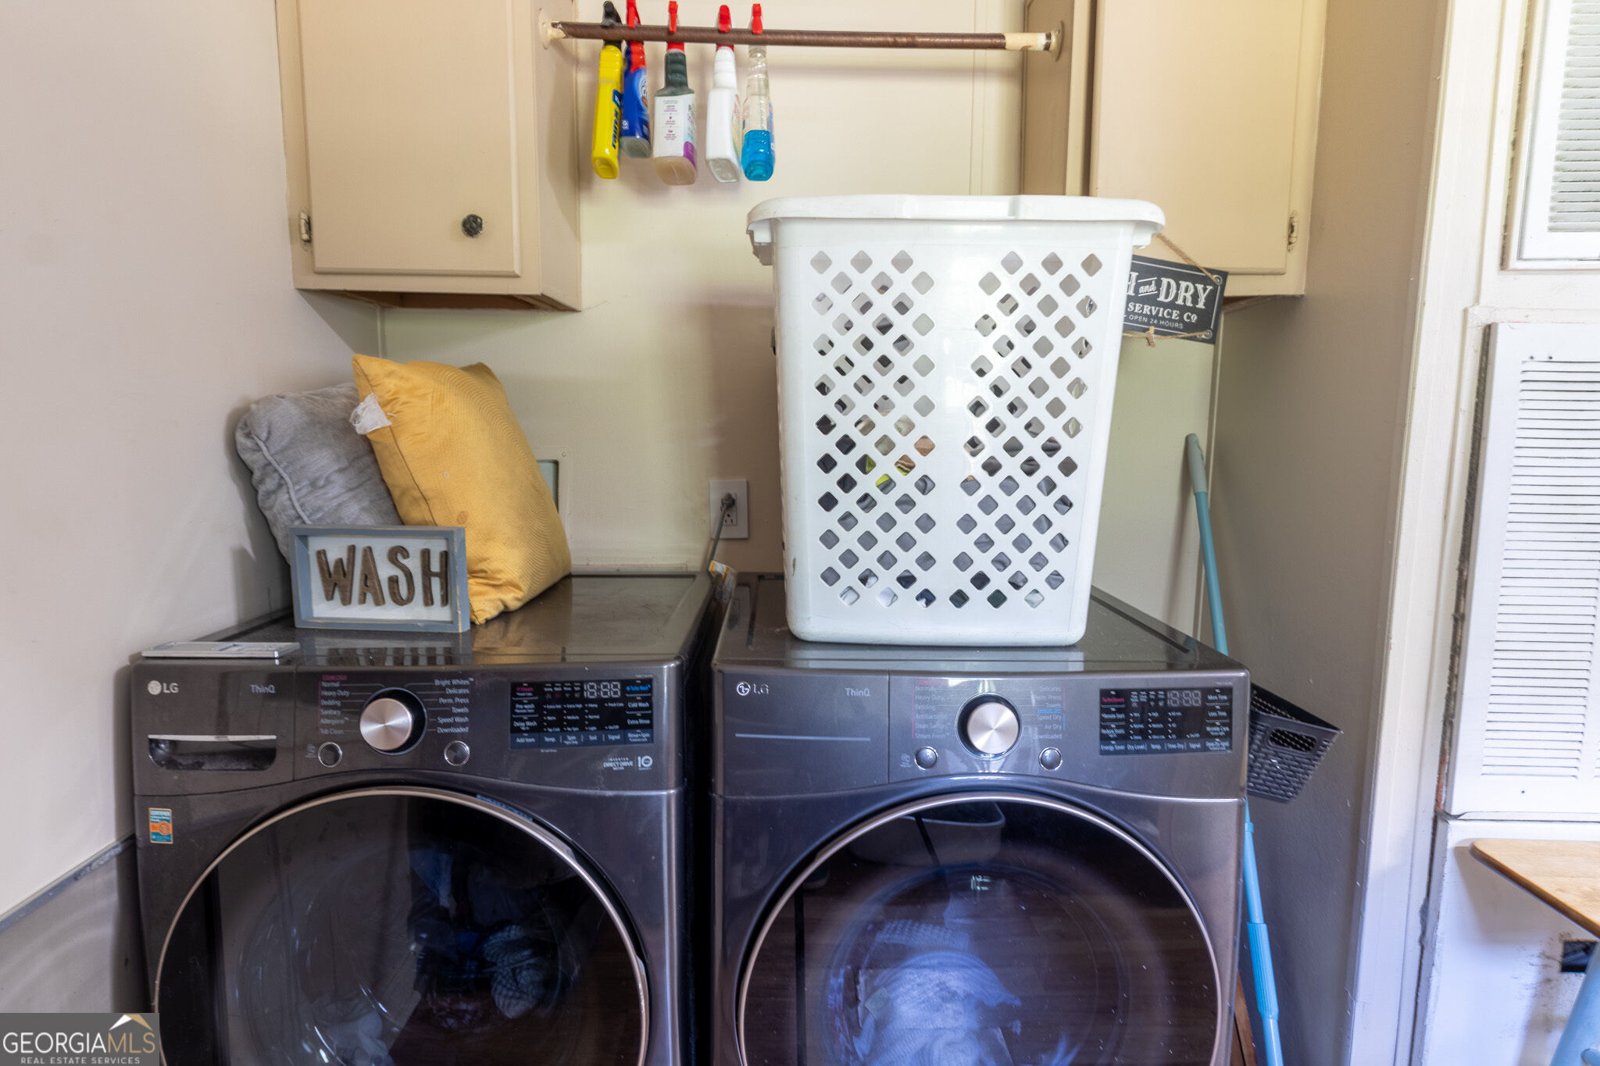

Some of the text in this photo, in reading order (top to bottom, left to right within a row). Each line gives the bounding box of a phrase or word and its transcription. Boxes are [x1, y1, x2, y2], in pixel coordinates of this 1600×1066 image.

[1138, 280, 1157, 294] and
[1157, 277, 1213, 310] DRY
[1127, 301, 1180, 320] SERVICE
[1128, 314, 1148, 323] OPEN
[1159, 319, 1184, 329] HOURS
[315, 544, 450, 607] WASH
[162, 682, 180, 694] LG
[250, 684, 276, 694] ThinQ
[753, 682, 770, 695] LG
[844, 687, 871, 697] ThinQ
